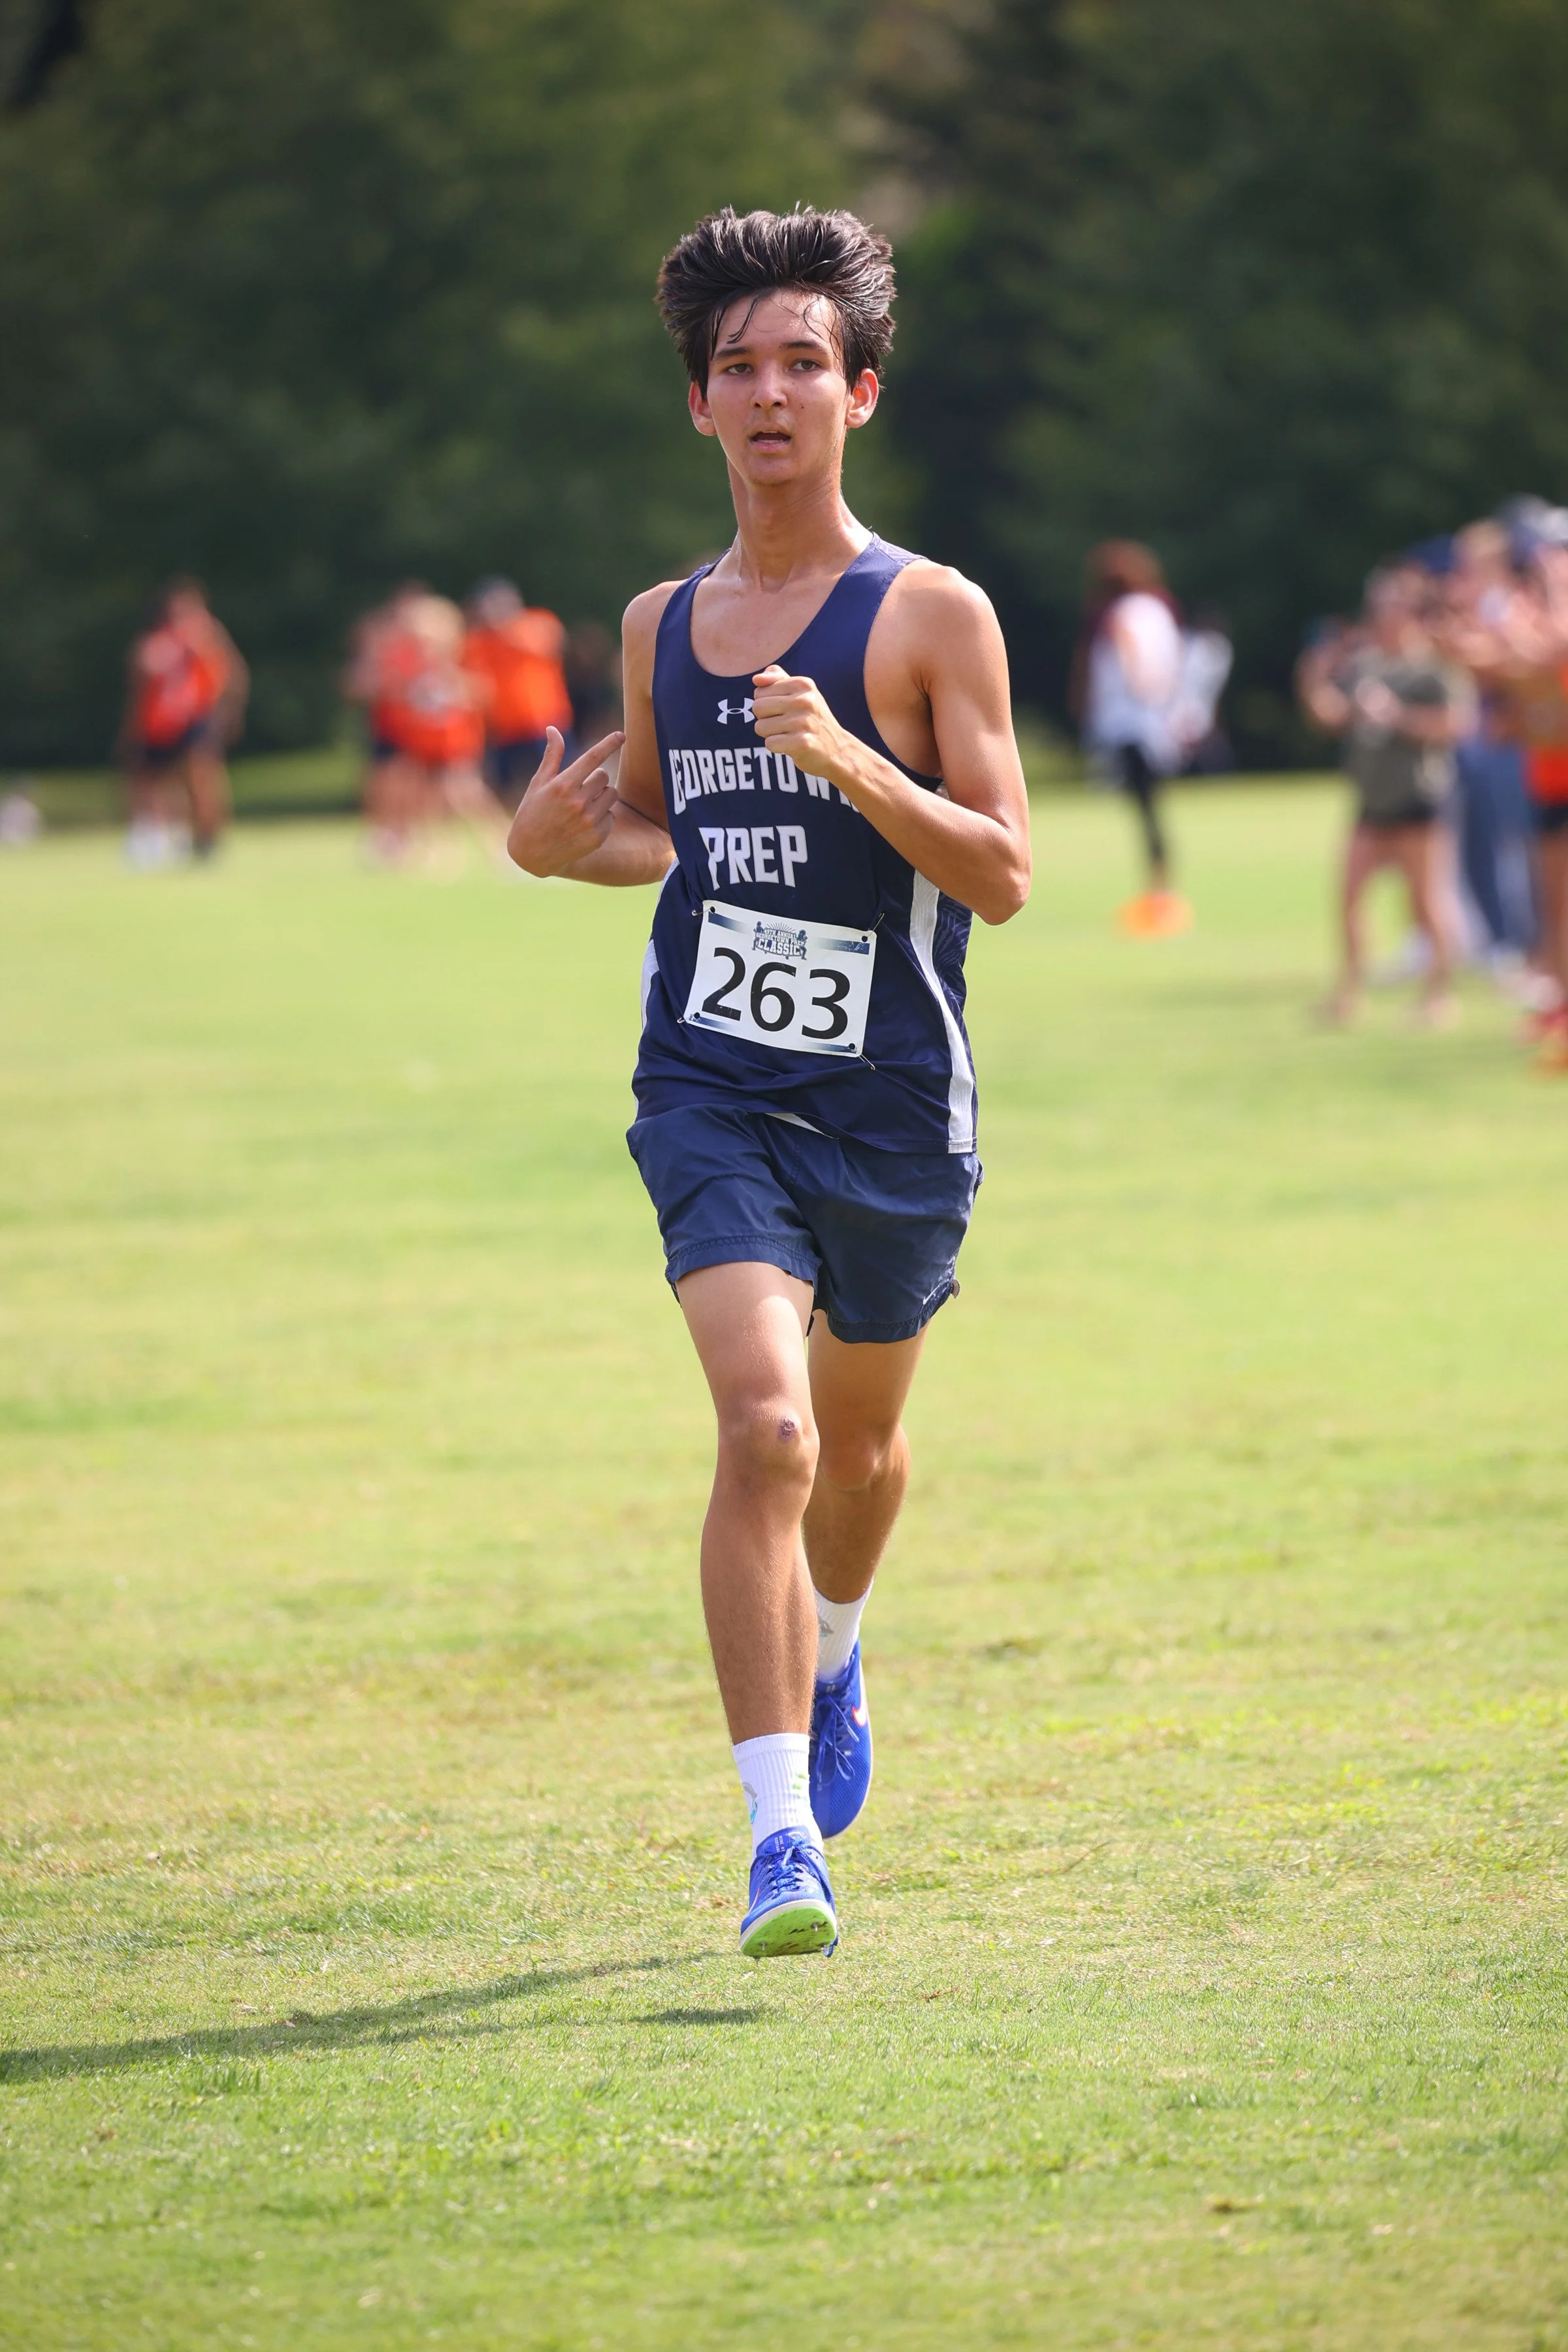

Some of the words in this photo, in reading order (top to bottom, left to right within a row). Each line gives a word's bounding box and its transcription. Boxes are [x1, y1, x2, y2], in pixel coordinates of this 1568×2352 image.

[668, 746, 859, 815] GEORGETO
[698, 825, 808, 890] PREP
[756, 933, 789, 943] GEORGETOWN
[757, 938, 801, 955] CLASSIC
[777, 931, 796, 939] ANNUAL
[702, 947, 850, 1039] 263
